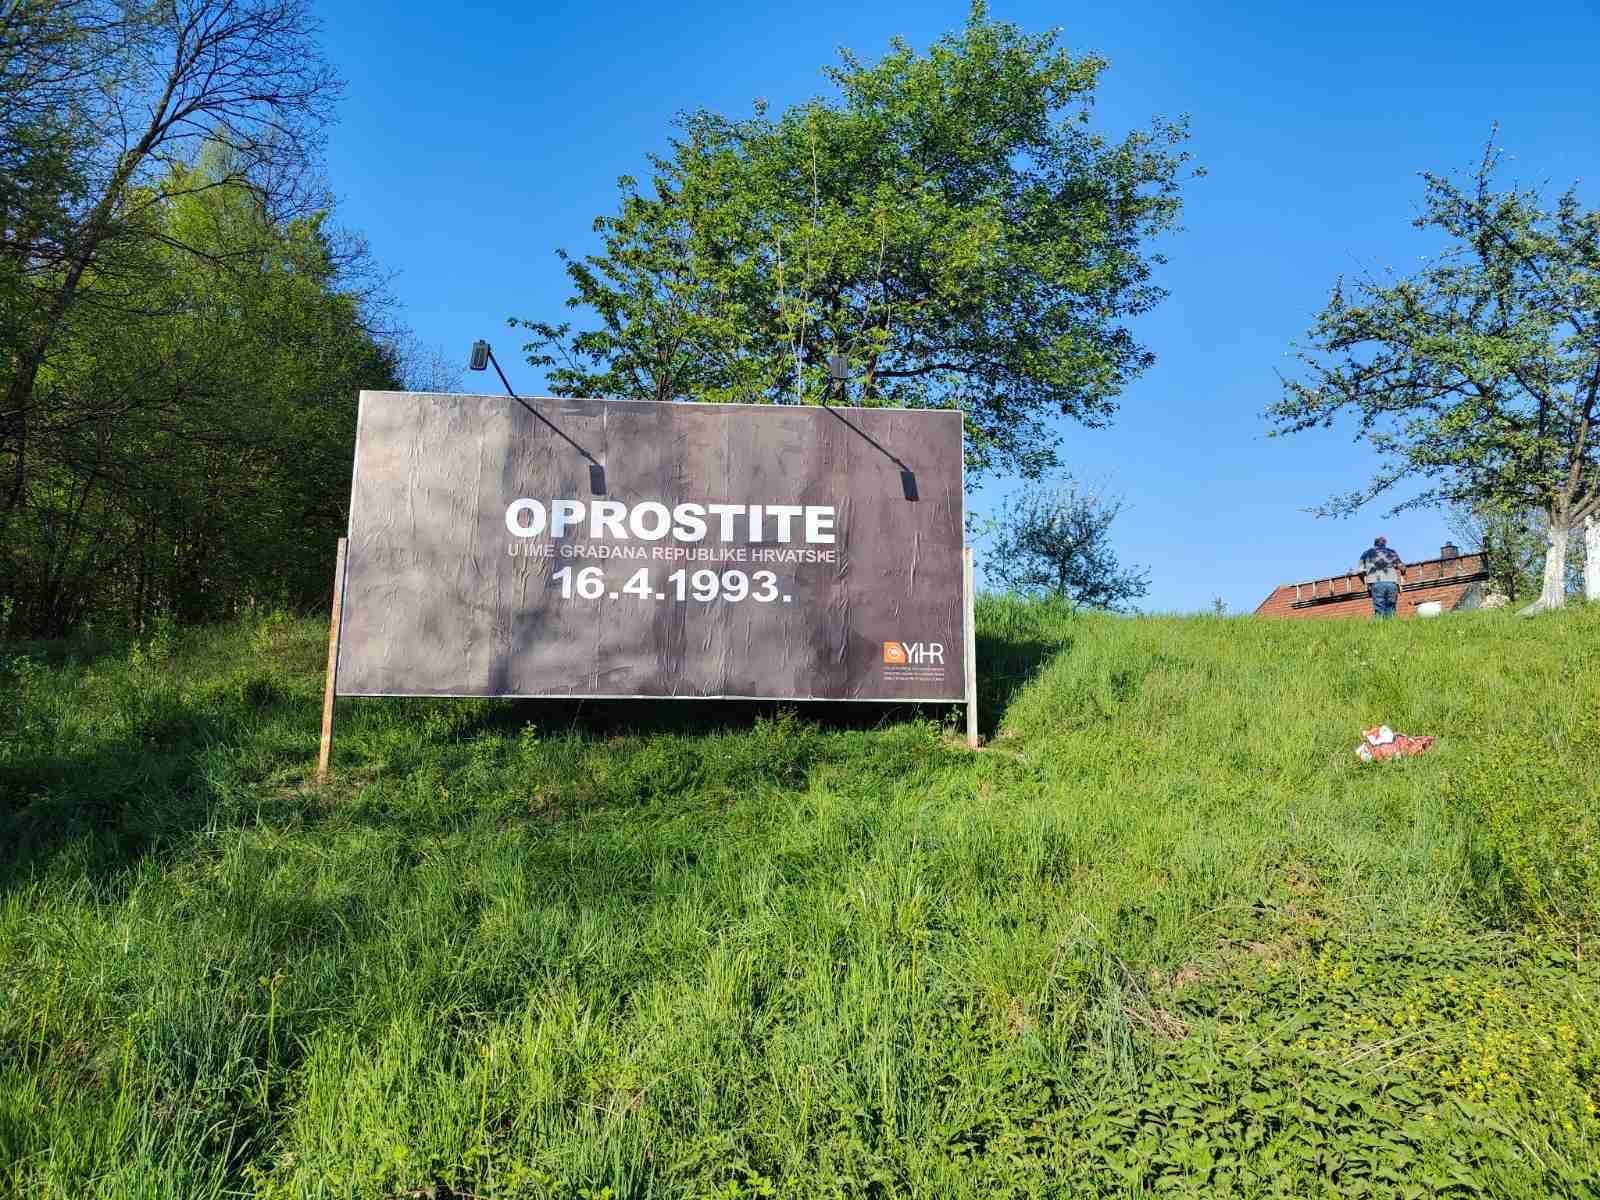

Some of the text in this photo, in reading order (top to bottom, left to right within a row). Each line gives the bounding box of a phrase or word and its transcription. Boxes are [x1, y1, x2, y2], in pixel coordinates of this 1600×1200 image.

[505, 497, 836, 544] OPROSTITE
[507, 543, 836, 564] U IME GRAĐANA REPUBLIKE HRVATSKE
[553, 566, 792, 603] 16.4.1993.
